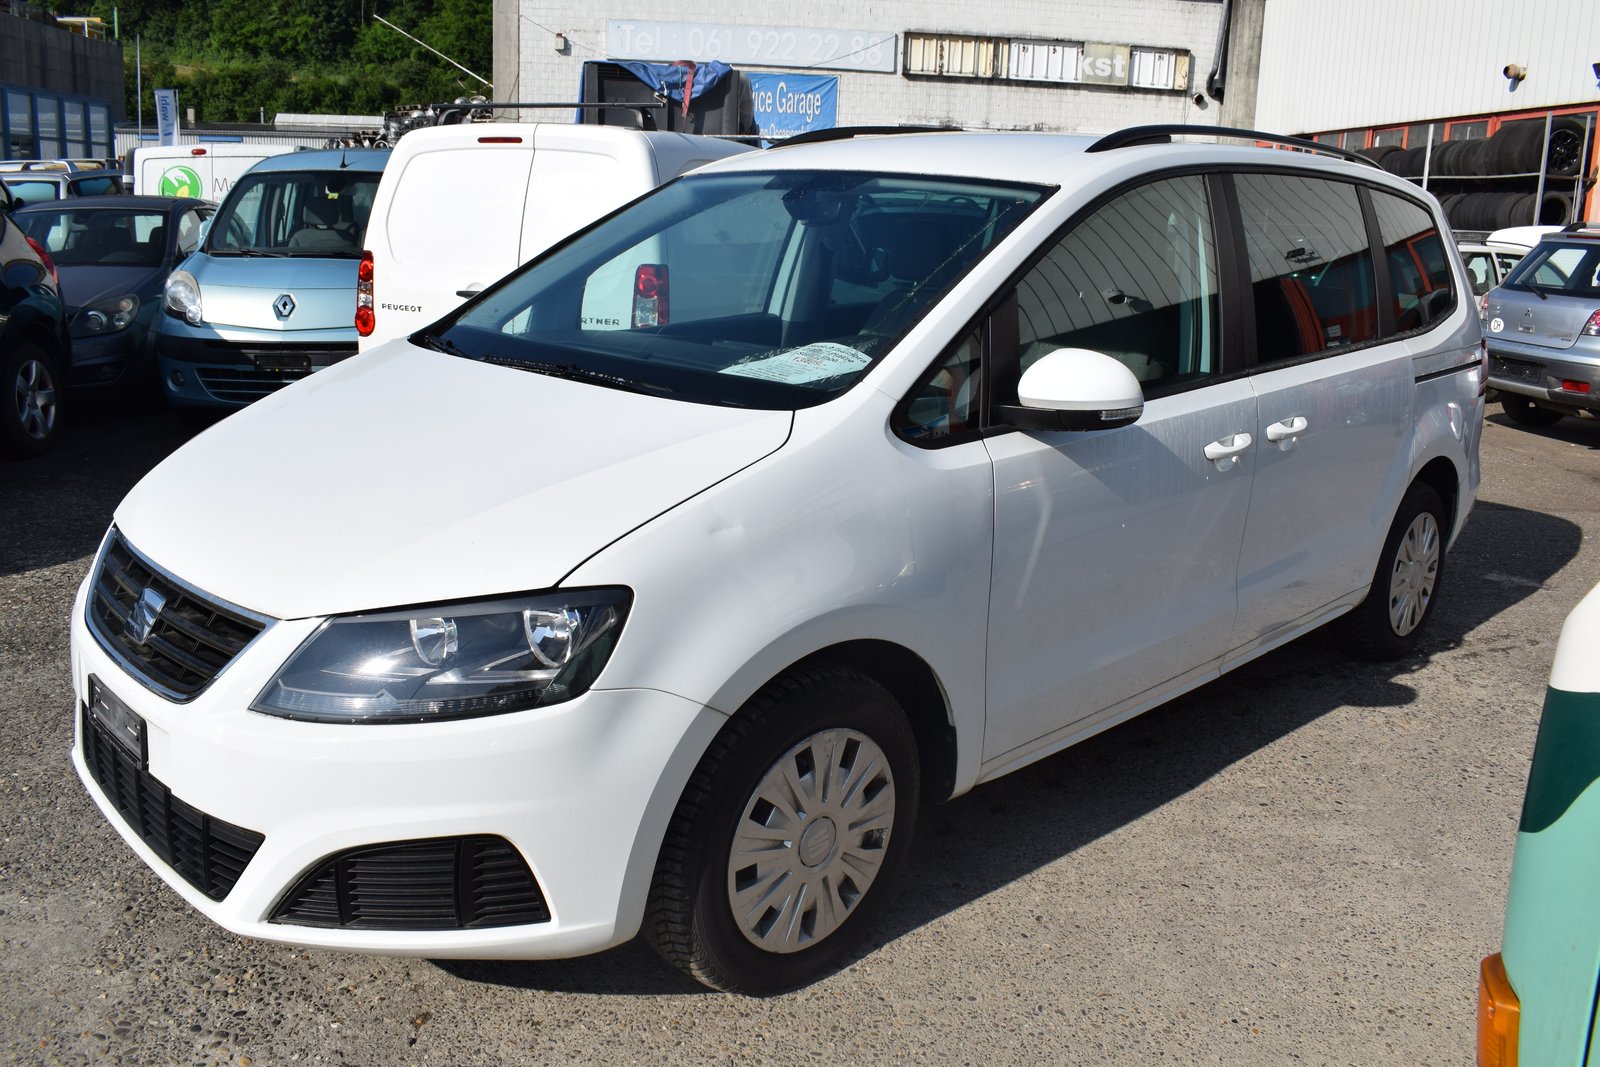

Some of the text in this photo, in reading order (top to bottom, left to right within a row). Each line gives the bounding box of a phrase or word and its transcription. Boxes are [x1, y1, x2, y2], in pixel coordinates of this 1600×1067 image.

[688, 27, 733, 59] 061
[747, 30, 798, 61] 922
[807, 32, 841, 63] 22
[850, 35, 882, 66] 88
[776, 81, 821, 123] Garage
[381, 303, 422, 312] PEUGEOT
